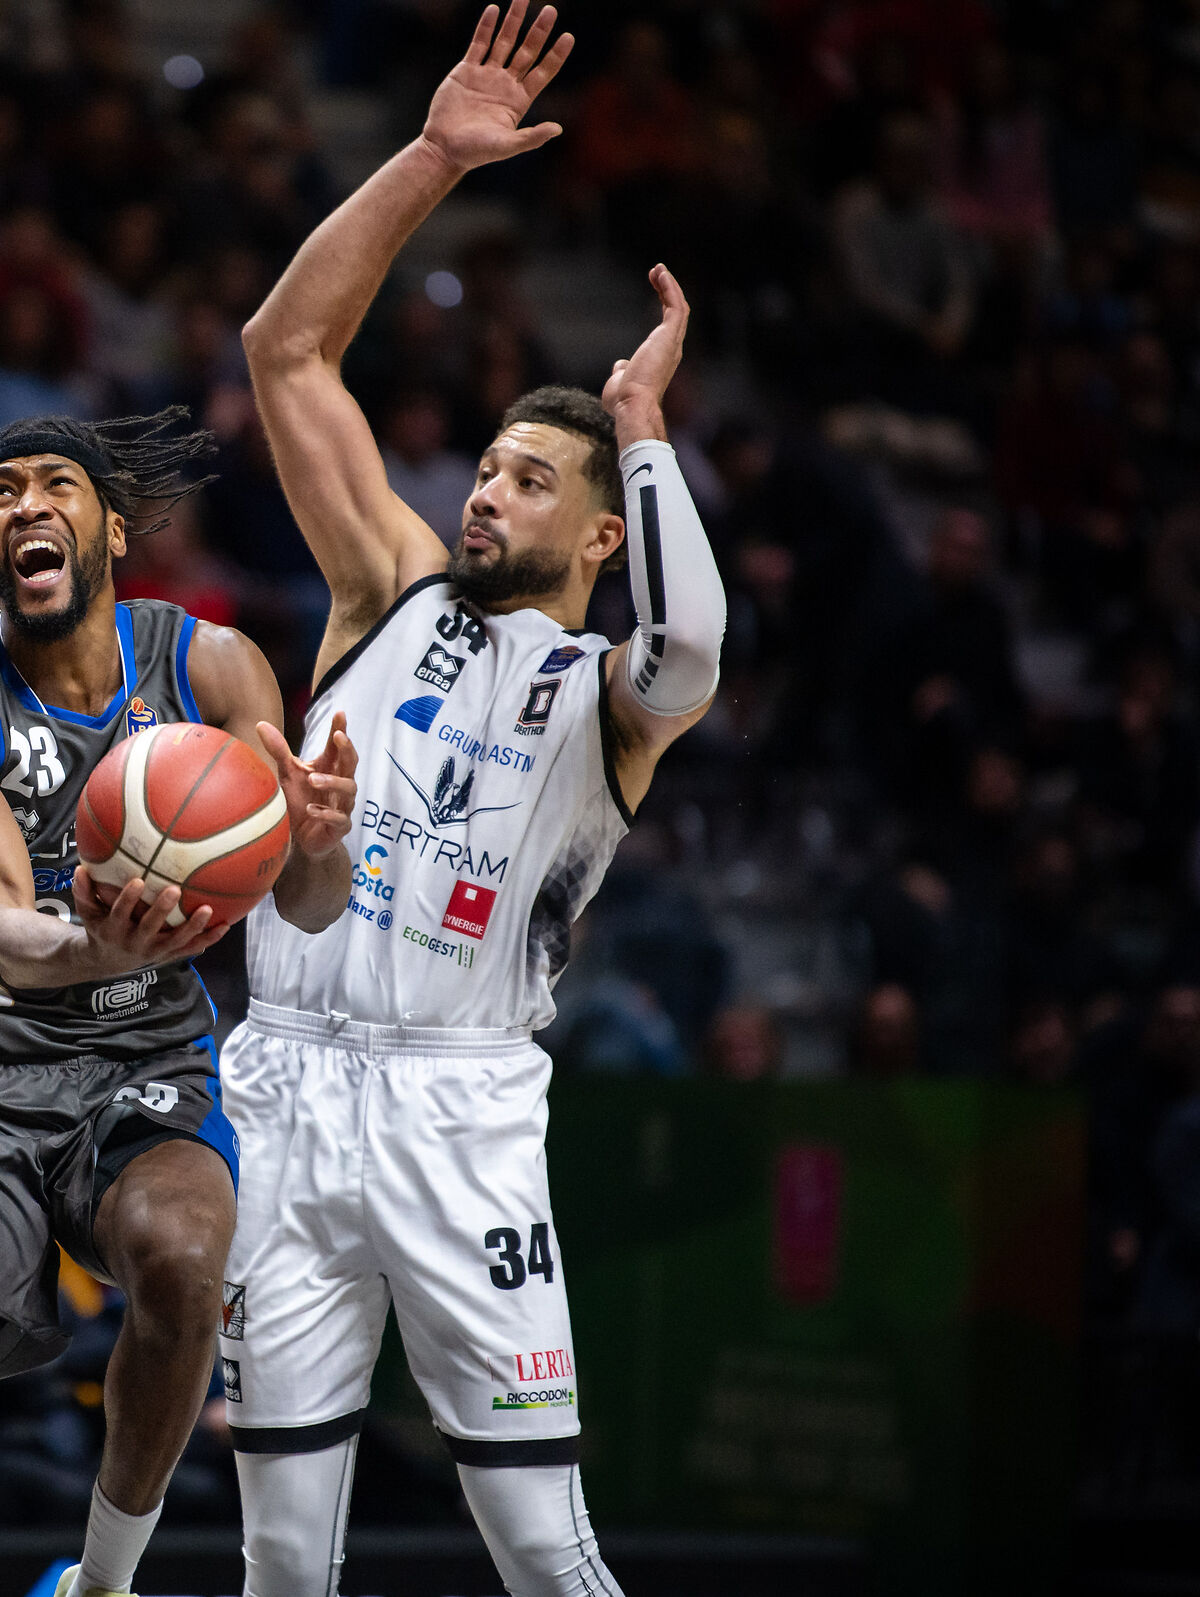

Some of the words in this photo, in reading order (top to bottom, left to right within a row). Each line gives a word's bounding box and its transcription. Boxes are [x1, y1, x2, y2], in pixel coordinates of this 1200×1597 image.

[131, 725, 153, 736] LB
[1, 726, 66, 798] 23
[361, 800, 509, 883] BERTRAM
[443, 914, 485, 935] SYNERGIE
[402, 926, 458, 958] ECOGEST
[97, 1001, 149, 1020] investments
[484, 1222, 554, 1291] 34
[513, 1349, 573, 1382] LERTA
